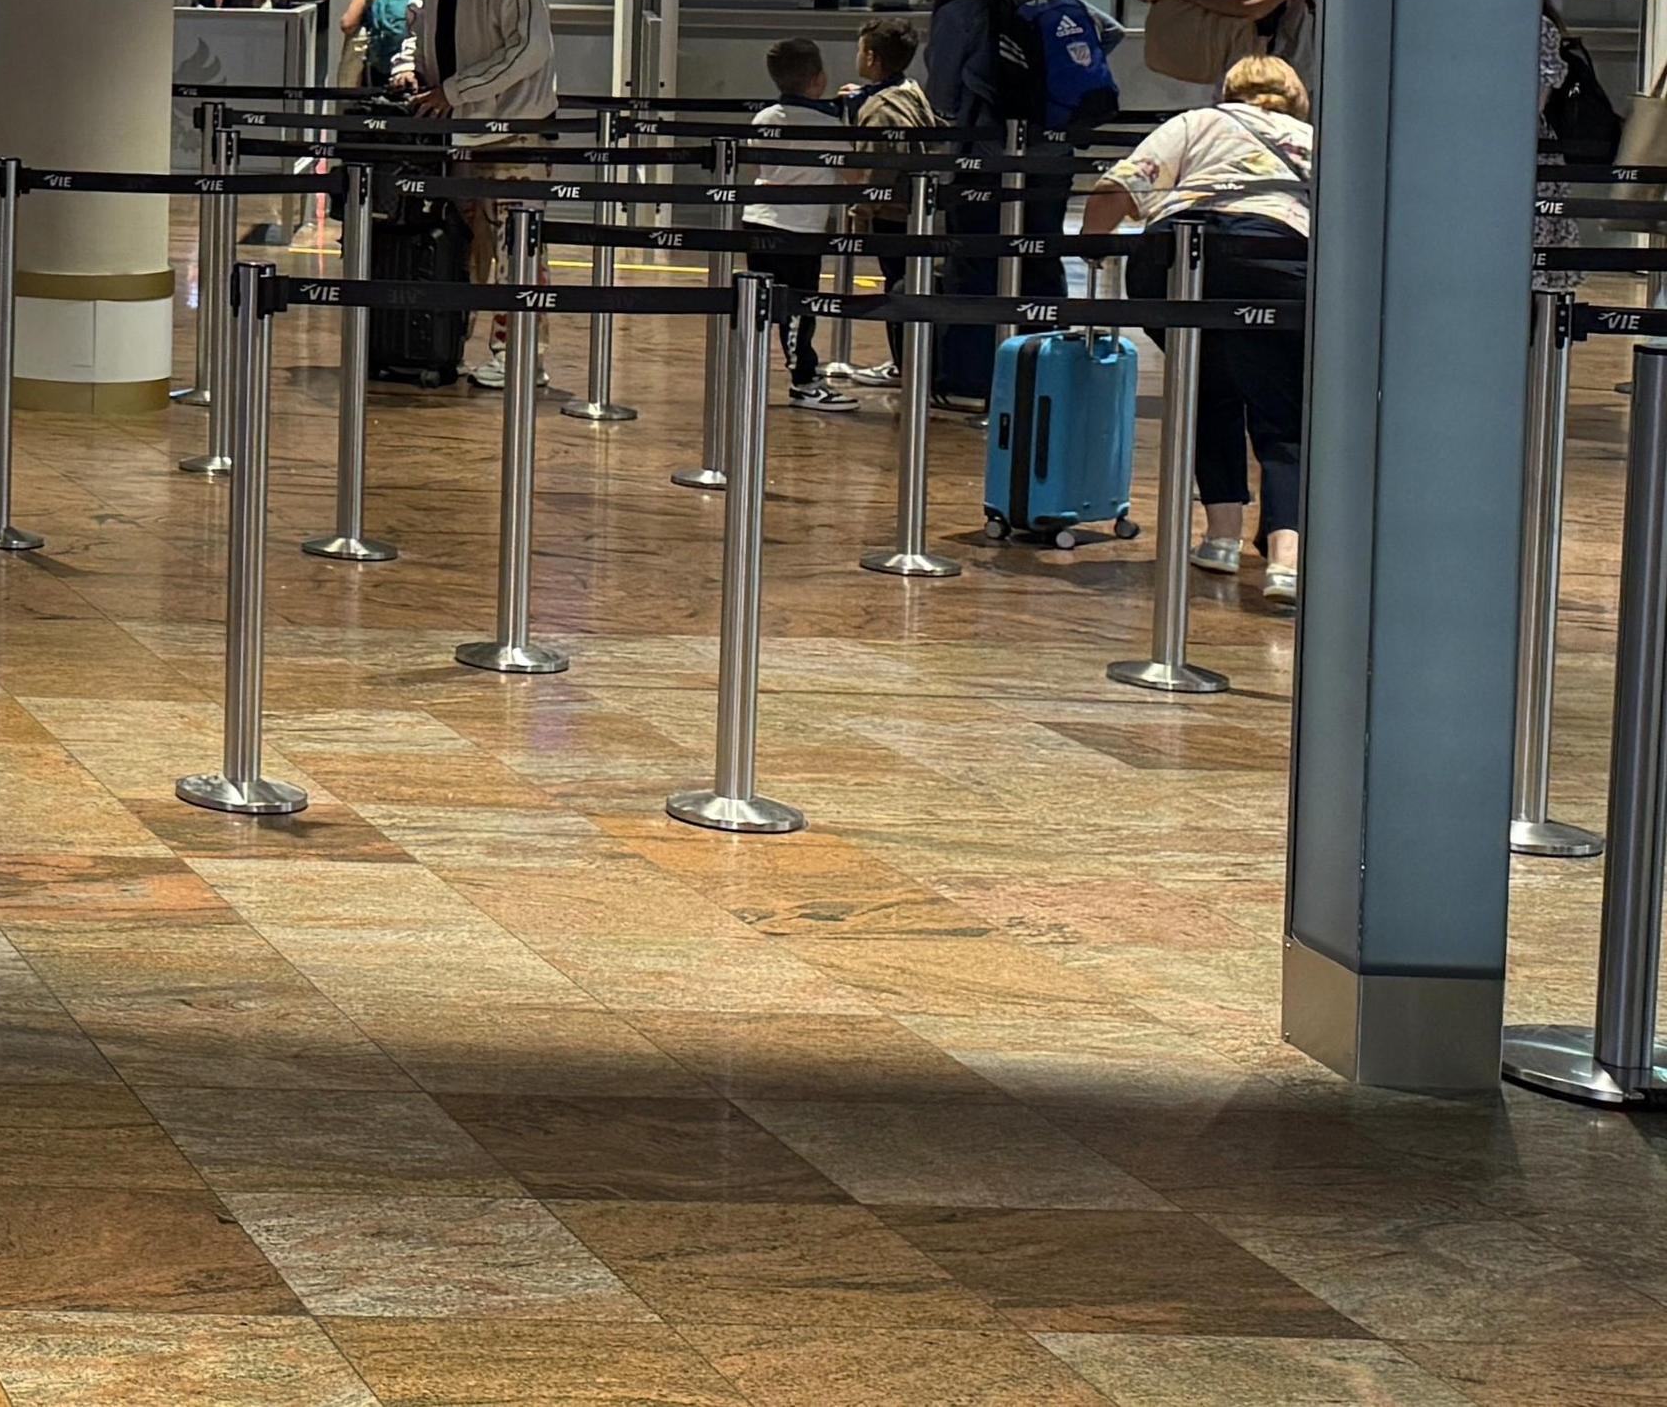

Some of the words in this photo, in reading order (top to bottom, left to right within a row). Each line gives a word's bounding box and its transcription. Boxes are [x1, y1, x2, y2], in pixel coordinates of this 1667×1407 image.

[244, 114, 266, 125] VIE
[365, 118, 387, 130] VIE
[487, 121, 510, 132] VIE
[636, 122, 658, 134] VIE
[759, 128, 782, 139] VIE
[1044, 130, 1067, 142] VIE
[310, 145, 334, 157] VIE
[449, 149, 473, 161] VIE
[585, 151, 610, 162] VIE
[820, 154, 846, 166] VIE
[956, 157, 983, 170] VIE
[45, 174, 72, 188] VIE
[1614, 168, 1639, 181] VIE
[197, 178, 224, 191] VIE
[397, 179, 426, 193] VIE
[553, 185, 581, 199] VIE
[708, 188, 737, 202] VIE
[865, 188, 893, 201] VIE
[1537, 201, 1564, 215] VIE
[652, 231, 684, 247] VIE
[832, 238, 864, 253] VIE
[1012, 238, 1046, 254] VIE
[1532, 253, 1547, 266] IE
[303, 284, 341, 302] VIE
[518, 292, 558, 308] VIE
[804, 297, 843, 314] VIE
[1020, 304, 1059, 321] VIE
[1237, 307, 1277, 325] VIE
[1601, 313, 1641, 331] VIE
